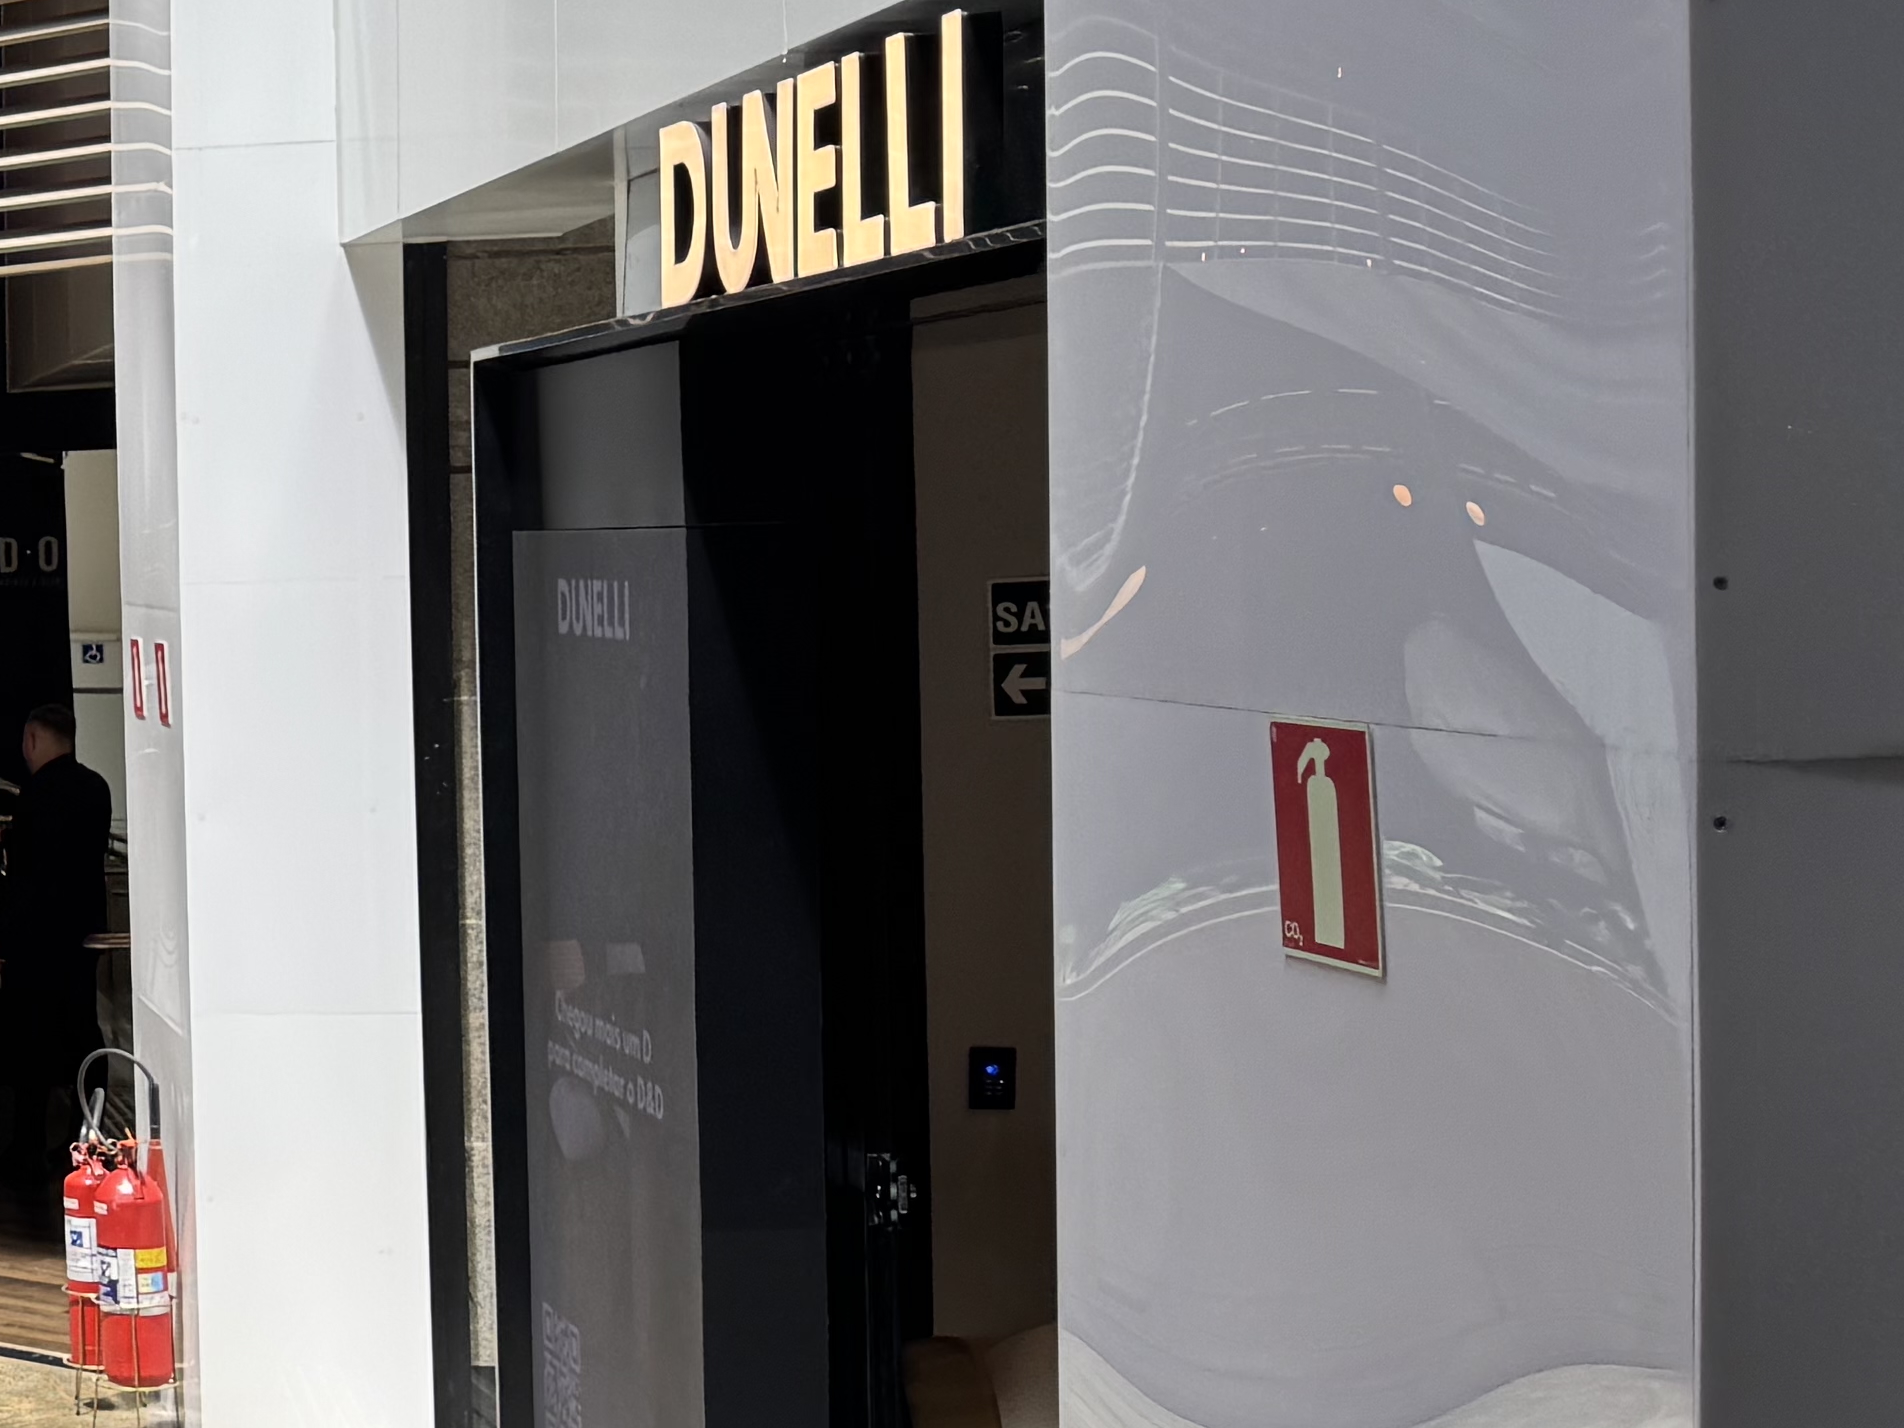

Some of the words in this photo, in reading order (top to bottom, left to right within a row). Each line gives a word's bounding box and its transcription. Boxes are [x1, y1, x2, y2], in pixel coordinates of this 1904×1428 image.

[658, 8, 965, 310] DUNELLI
[557, 578, 630, 641] DUNELLI
[594, 1012, 621, 1052] mais
[622, 1030, 642, 1061] um
[642, 1028, 653, 1065] D
[626, 1080, 636, 1106] o
[636, 1074, 665, 1121] D&D
